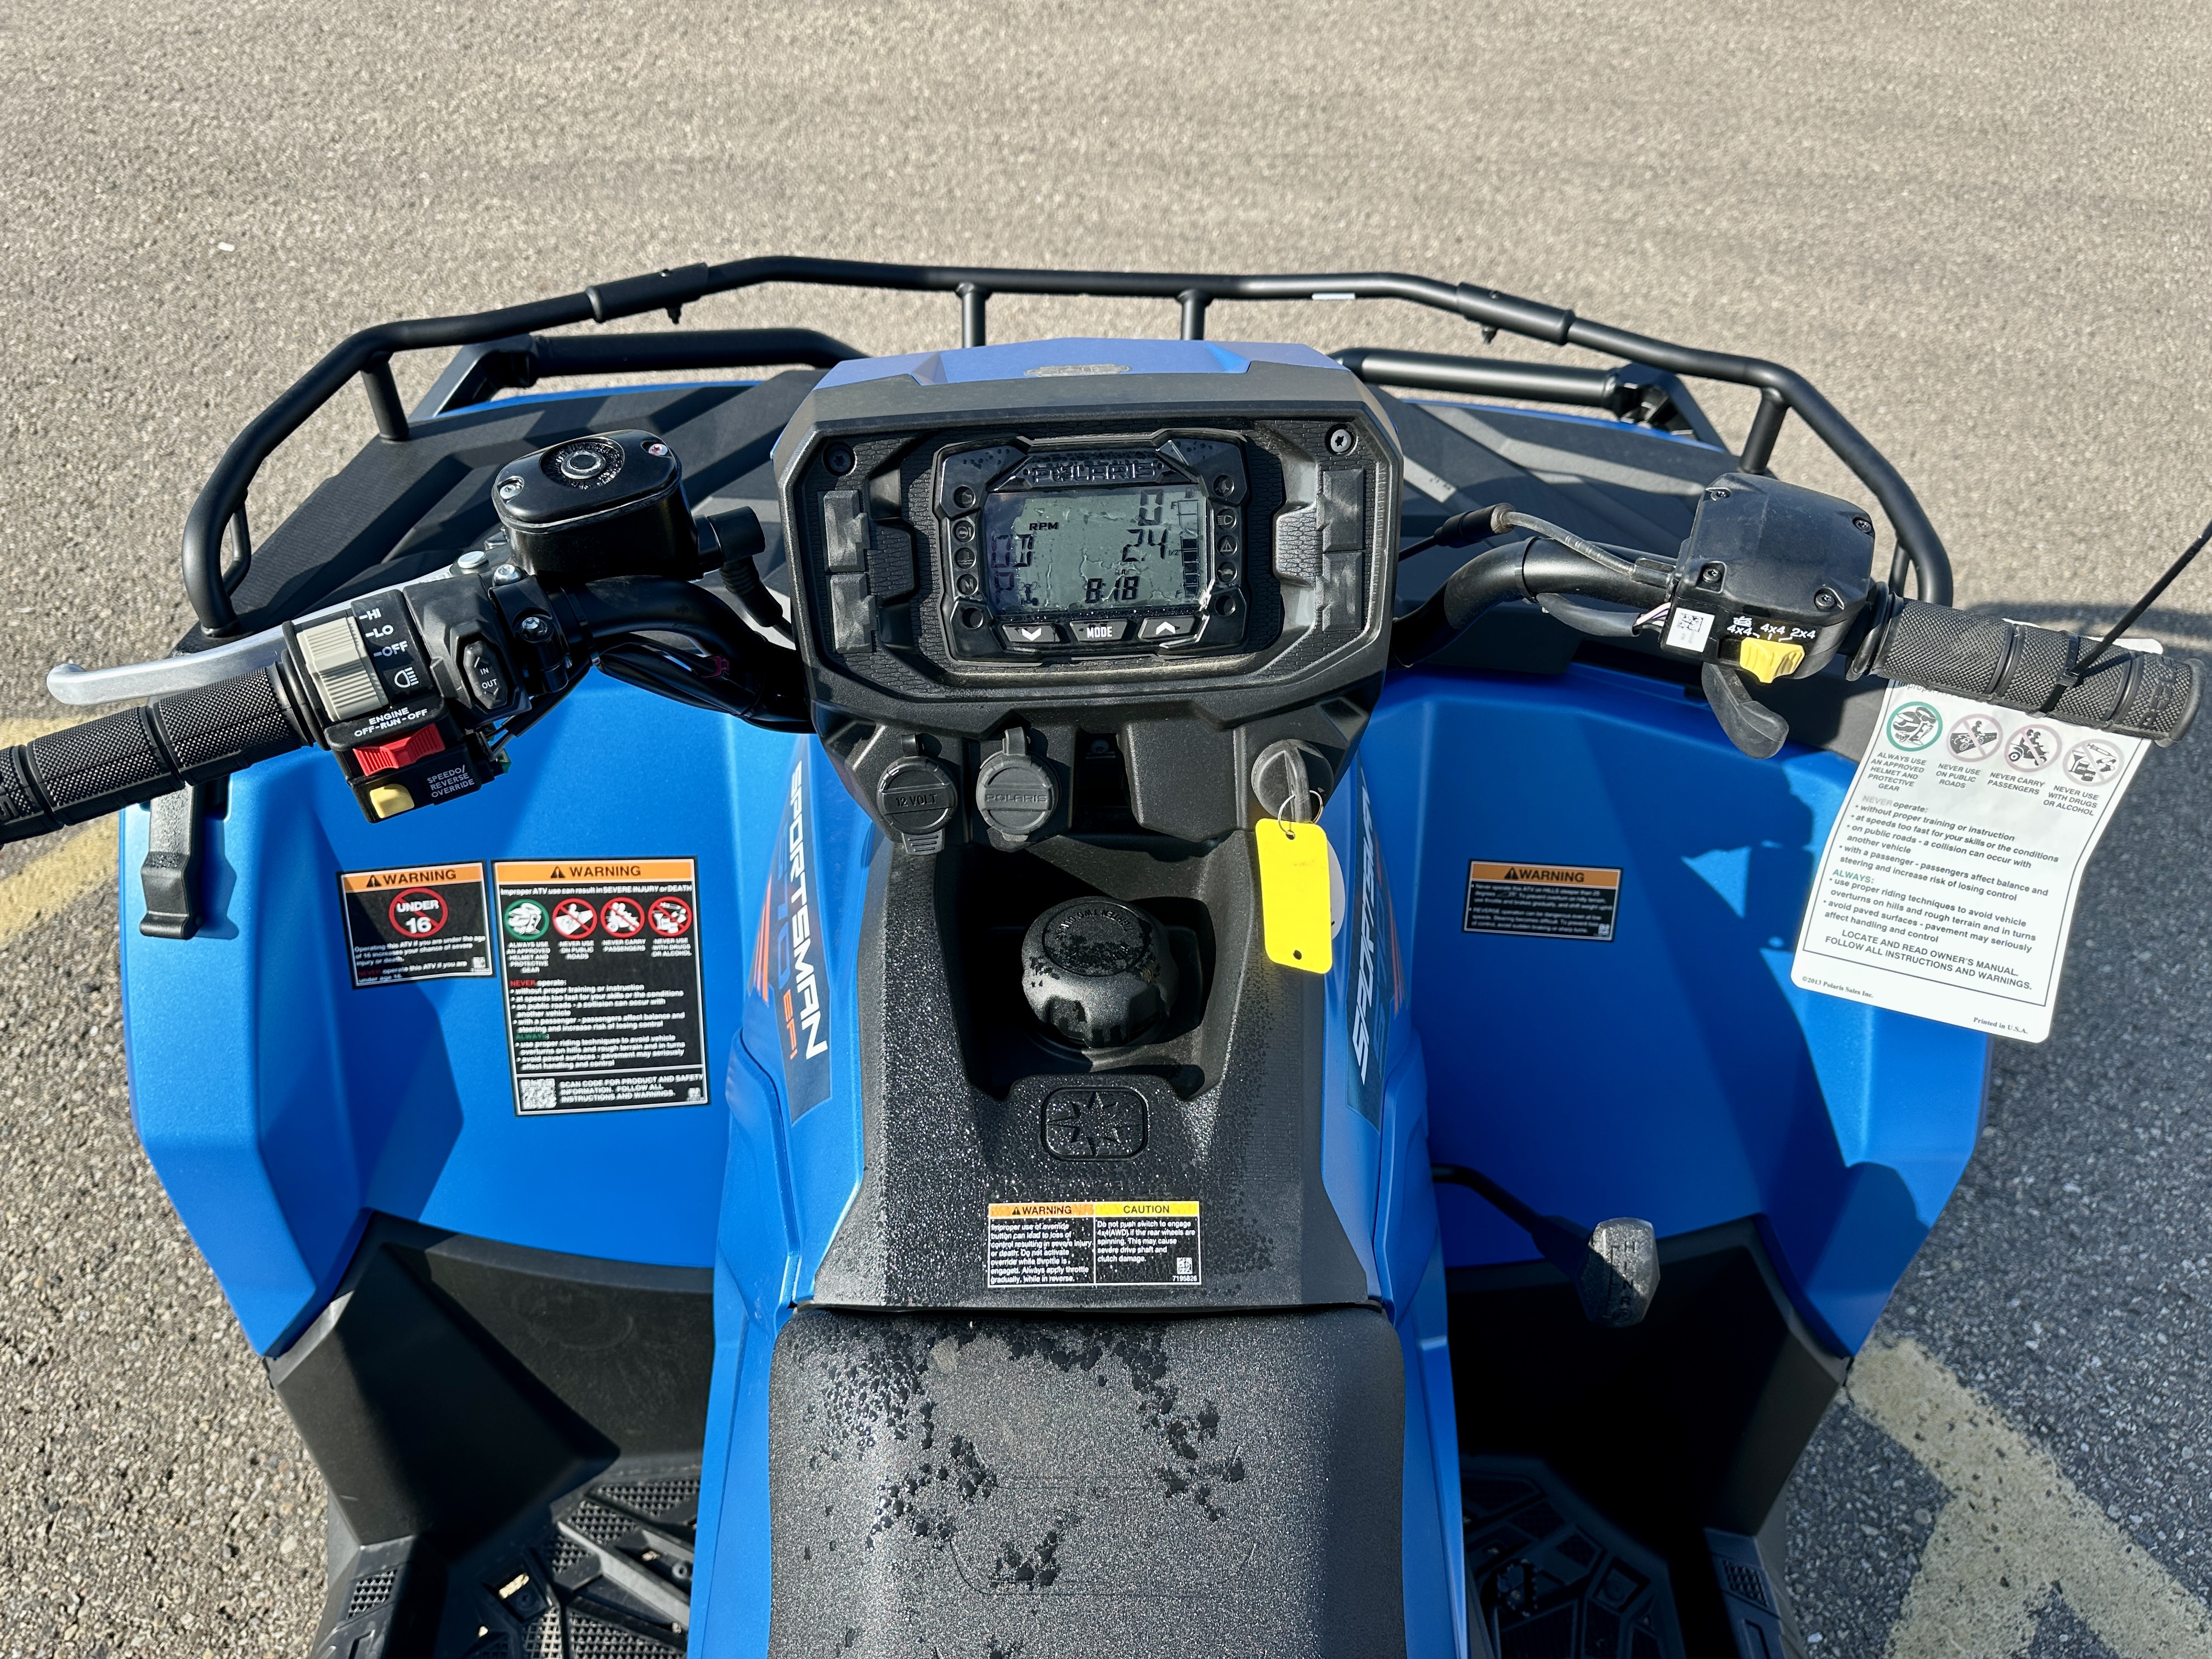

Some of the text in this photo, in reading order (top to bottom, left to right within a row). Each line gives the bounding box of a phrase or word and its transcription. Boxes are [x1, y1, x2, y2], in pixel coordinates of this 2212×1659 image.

[1032, 463, 1154, 482] POLARIS
[1029, 521, 1059, 531] RPM
[1087, 626, 1113, 639] MODE
[1727, 625, 1752, 636] 4x4
[1760, 623, 1816, 639] 4x4 2x4
[479, 667, 489, 675] IN
[482, 679, 498, 689] OUT
[369, 707, 409, 725] ENGINE
[1877, 752, 1909, 762] ALWAYS
[1870, 766, 1901, 776] HELMET
[1883, 761, 1925, 772] APPROVED
[1938, 763, 1964, 772] NEVER
[427, 765, 466, 784] SPEEDO/
[430, 772, 470, 791] REVERSE
[1867, 774, 1915, 787] PROTECTIVE
[1948, 772, 1976, 782] PUBLIC
[1989, 772, 2045, 787] NEVER CARRY
[431, 778, 475, 798] OVERRIDE
[1939, 779, 1966, 788] ROADS
[1987, 780, 2040, 794] PASSENGERS
[2053, 785, 2080, 796] NEVER
[896, 793, 938, 808] 12 VOLT
[986, 793, 1048, 803] POLARIS
[1862, 795, 1928, 812] NEVER operate:
[2049, 792, 2097, 808] WITH DRUGS
[2056, 803, 2094, 816] ALCOHOL
[1861, 805, 1892, 816] without
[1892, 812, 1921, 821] proper
[1923, 817, 1955, 830] training
[1968, 826, 2015, 842] instruction
[1847, 836, 1911, 854] another vehicle
[1866, 817, 1896, 827] speeds
[1914, 826, 1930, 835] fast
[1964, 837, 1985, 846] skills
[1997, 844, 2011, 852] the
[2013, 848, 2058, 862] conditions
[1864, 828, 1891, 837] public
[1892, 834, 1916, 843] roads
[1931, 842, 1967, 854] collision
[1987, 854, 2012, 864] occur
[2013, 860, 2031, 868] with
[383, 870, 456, 885] WARNING
[569, 866, 641, 878] WARNING
[1519, 869, 1585, 883] WARNING
[1833, 869, 1874, 883] ALWAYS:
[603, 885, 632, 894] SEVERE
[633, 885, 659, 893] INJURY
[396, 900, 439, 913] UNDER
[791, 760, 828, 1059] SPORTSMAN
[1851, 883, 1880, 893] proper
[1881, 889, 1906, 901] riding
[1909, 895, 1955, 911] techniques
[1968, 910, 1993, 919] avoid
[1995, 915, 2026, 927] vehicle
[406, 917, 432, 934] 16
[1825, 912, 1849, 922] affect
[1850, 916, 1887, 932] handling
[1908, 932, 1939, 943] control
[1842, 929, 1878, 944] LOCATE
[1880, 939, 1900, 949] AND
[1902, 944, 1928, 955] READ
[1930, 950, 1974, 966] OWNER'S
[1825, 936, 2032, 990] FOLLOW ALL INSTRUCTIONS AND WARNINGS.
[1823, 981, 1843, 990] Polaris
[783, 989, 798, 1060] EFI
[1973, 1017, 1996, 1026] Printed
[1022, 1206, 1072, 1215] WARNING
[1124, 1205, 1170, 1214] CAUTION
[1120, 1220, 1136, 1228] push
